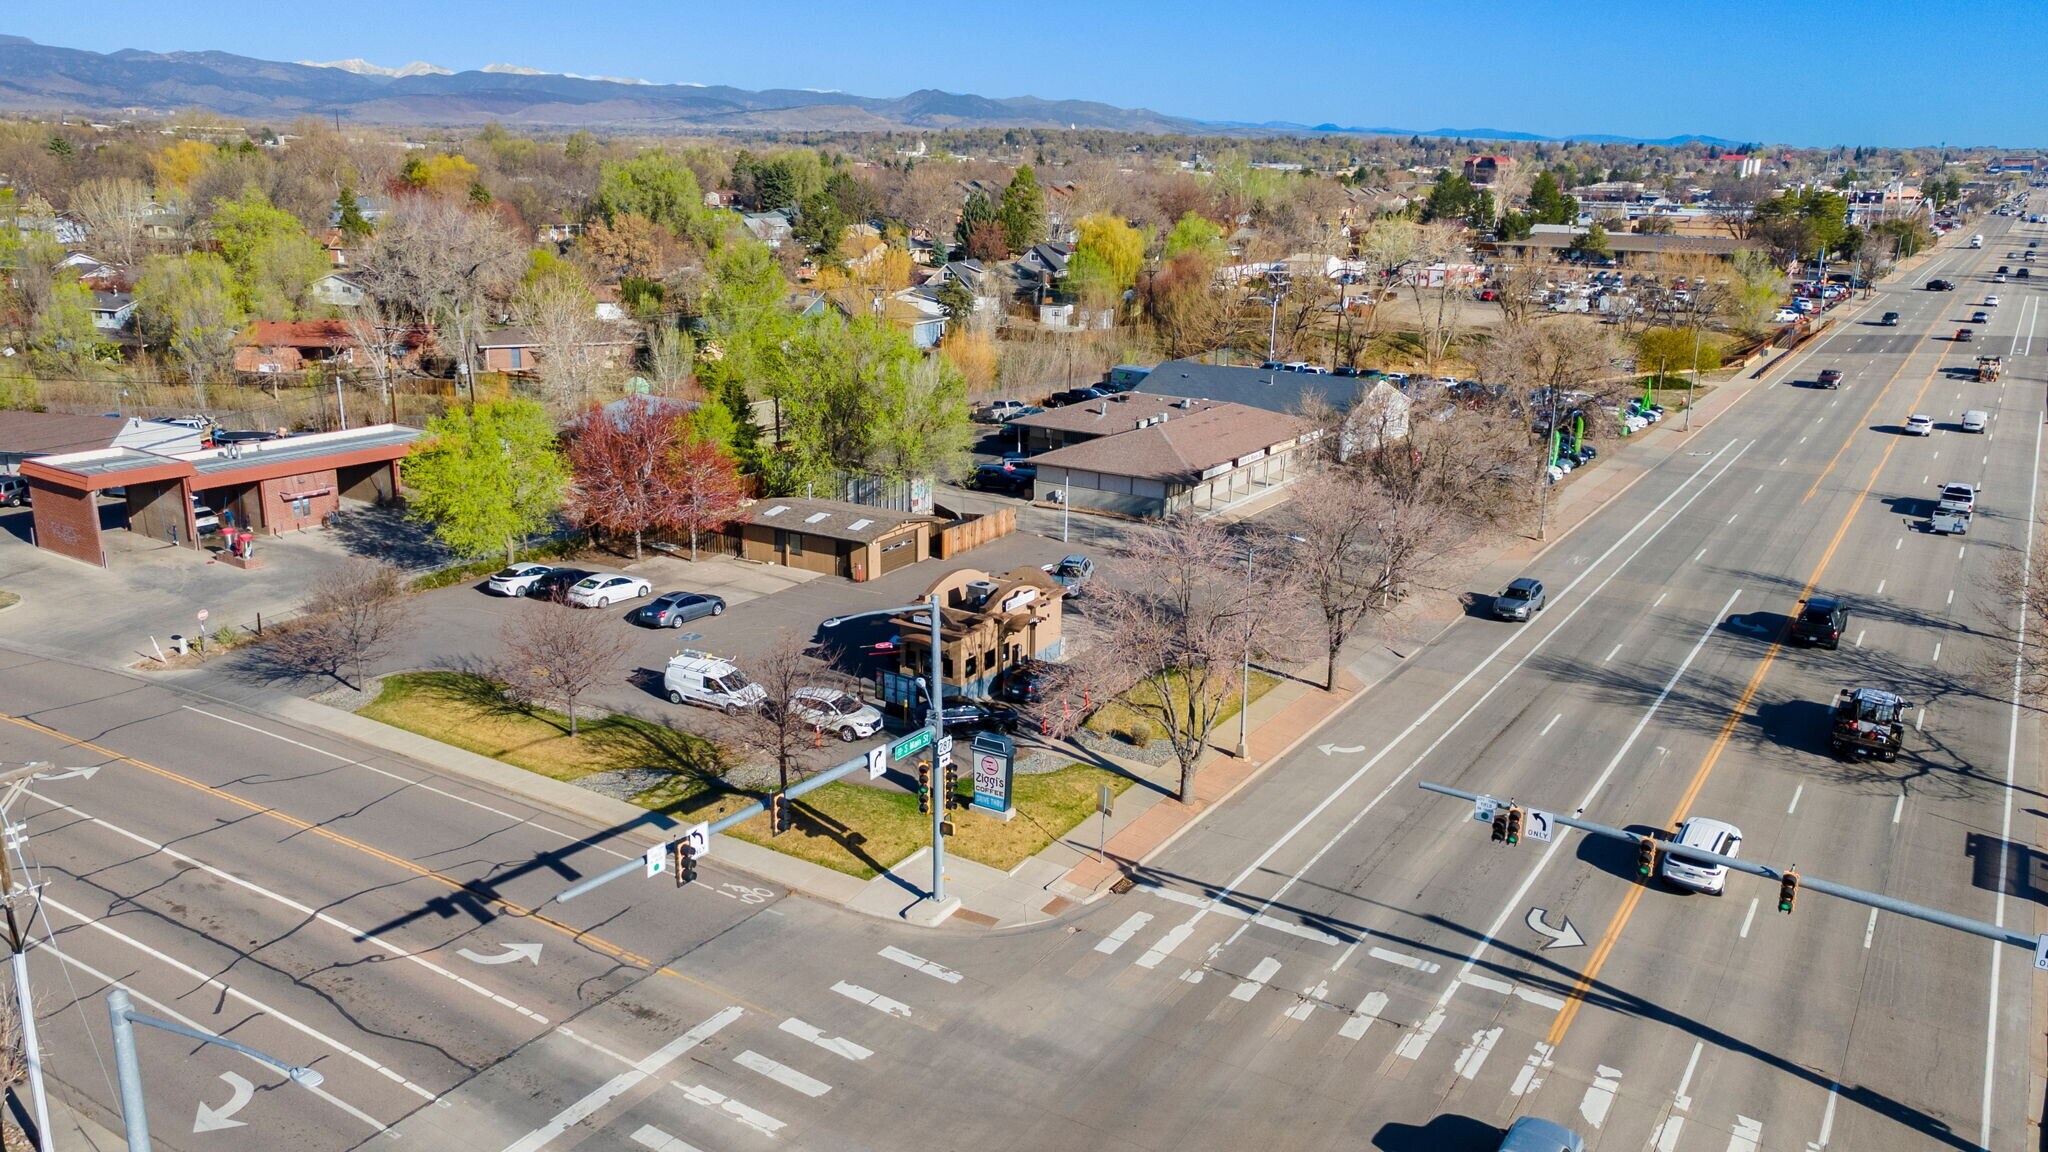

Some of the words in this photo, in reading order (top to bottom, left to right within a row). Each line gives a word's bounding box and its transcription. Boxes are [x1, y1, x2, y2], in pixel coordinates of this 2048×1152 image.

[939, 738, 951, 752] 287
[975, 772, 1004, 788] Ziggi's
[975, 785, 1004, 797] COFFEE
[1528, 829, 1548, 839] ONLY
